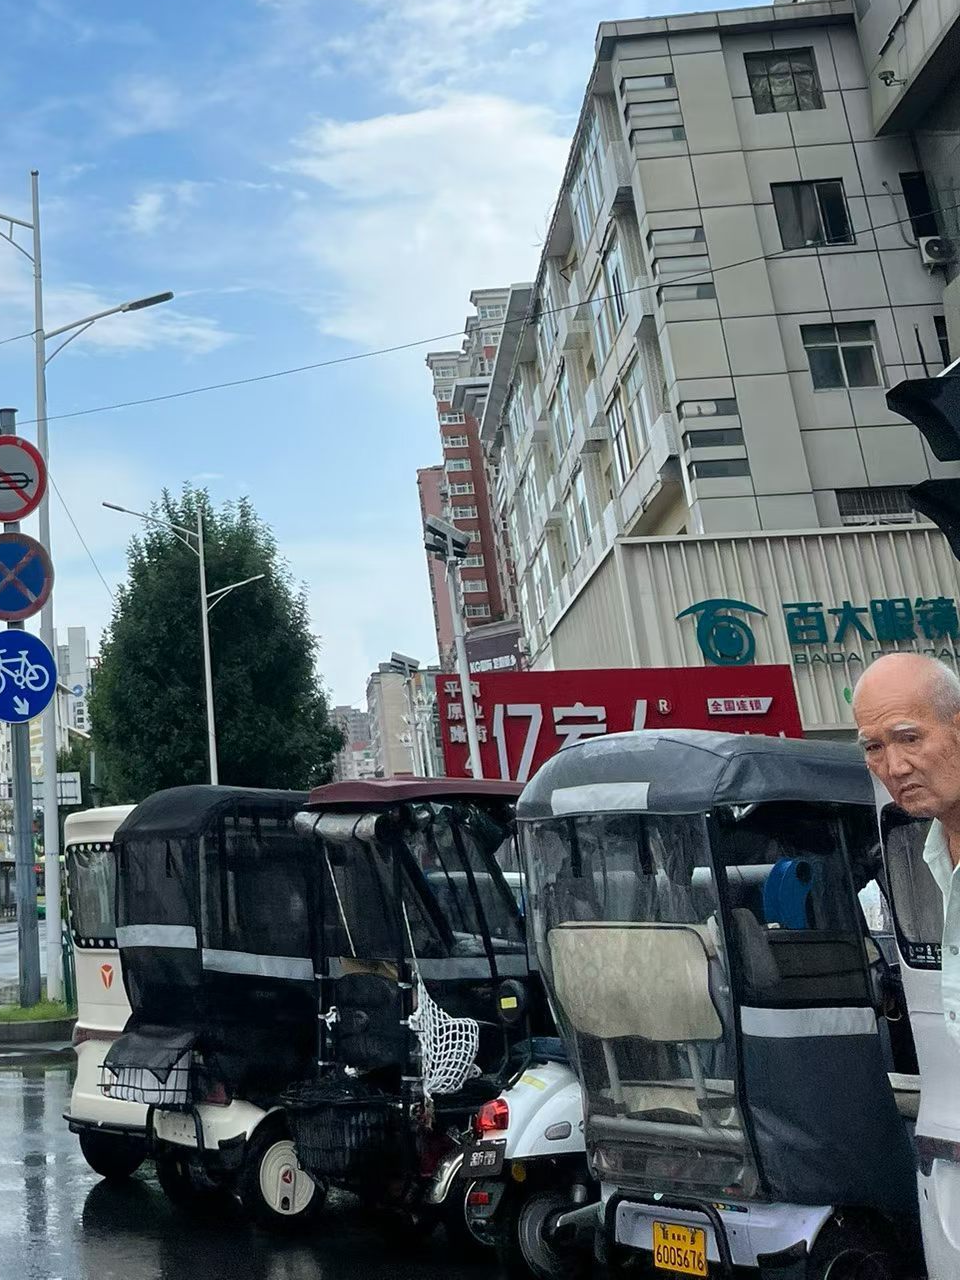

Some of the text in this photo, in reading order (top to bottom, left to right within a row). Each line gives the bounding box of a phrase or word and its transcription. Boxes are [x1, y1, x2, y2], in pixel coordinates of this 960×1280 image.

[782, 596, 960, 645] 百大眼镜
[794, 652, 862, 665] BAIDA
[710, 699, 763, 713] 全国连锁
[656, 1244, 704, 1271] 6005676
